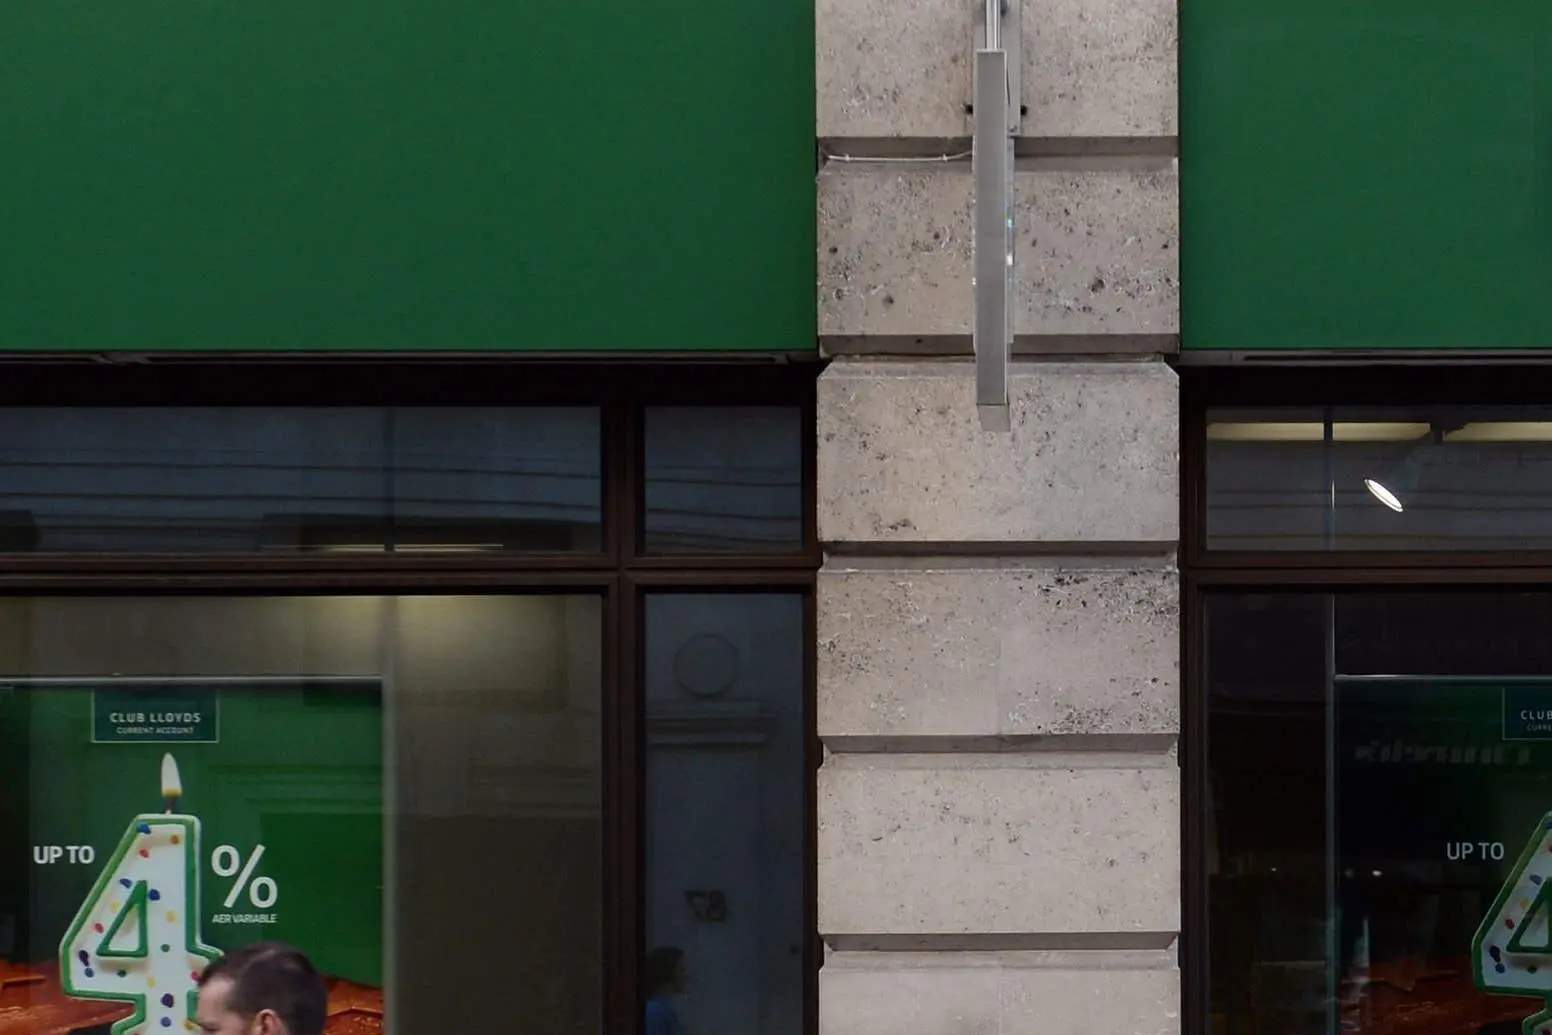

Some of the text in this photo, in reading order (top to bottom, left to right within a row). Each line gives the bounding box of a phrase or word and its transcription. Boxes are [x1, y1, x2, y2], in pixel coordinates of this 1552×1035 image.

[109, 712, 201, 723] CLUB LLOYDS
[1447, 842, 1474, 860] UP
[1477, 842, 1505, 860] TO
[34, 845, 63, 864] UP
[65, 845, 95, 864] TO
[211, 844, 278, 909] %
[211, 913, 278, 924] AER VARIABLE
